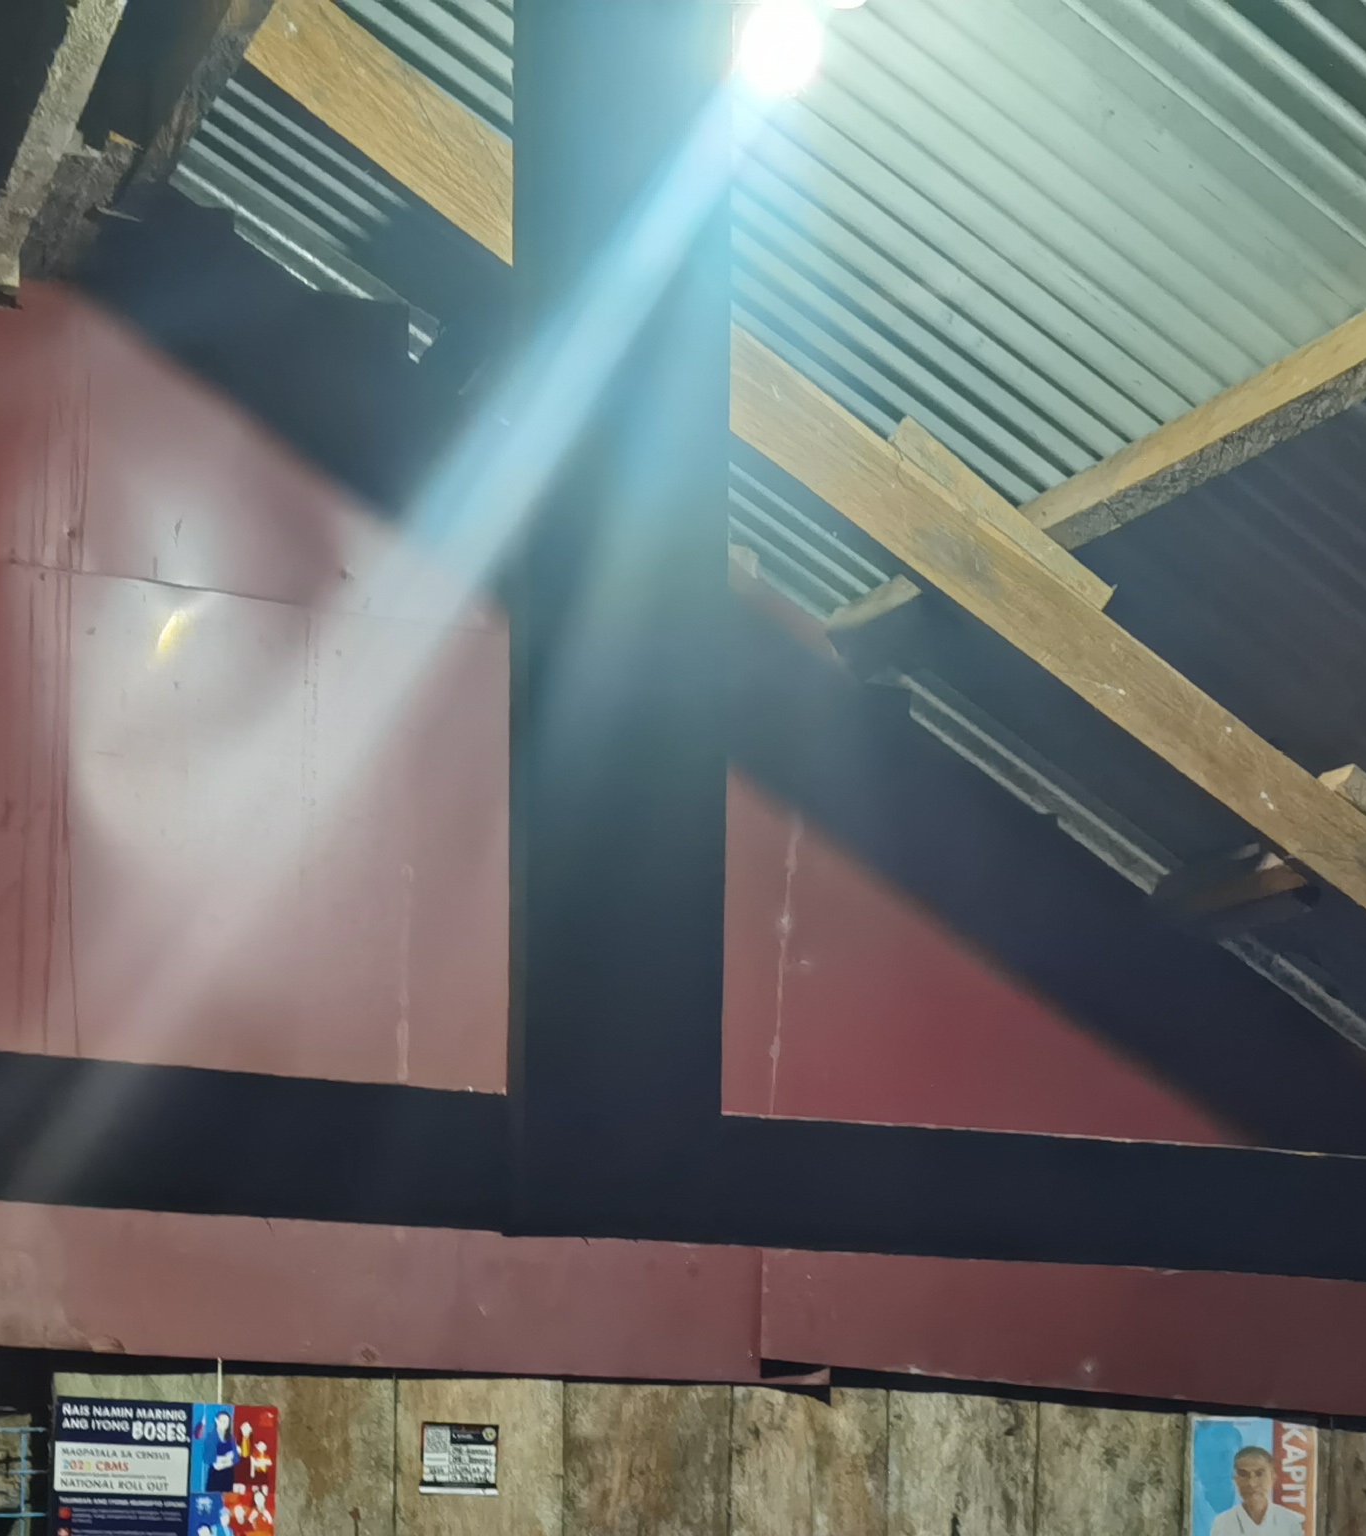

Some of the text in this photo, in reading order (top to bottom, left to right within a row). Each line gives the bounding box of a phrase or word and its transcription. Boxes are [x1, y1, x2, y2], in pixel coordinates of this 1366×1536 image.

[62, 1403, 187, 1422] NAIS NAMIN MARINIG
[62, 1418, 89, 1430] ANG
[91, 1420, 130, 1432] IYONG
[61, 1448, 171, 1461] MAGPATALA SA CENSUS
[95, 1461, 129, 1471] CBMS
[60, 1478, 169, 1492] NATIONAL ROLL OUT
